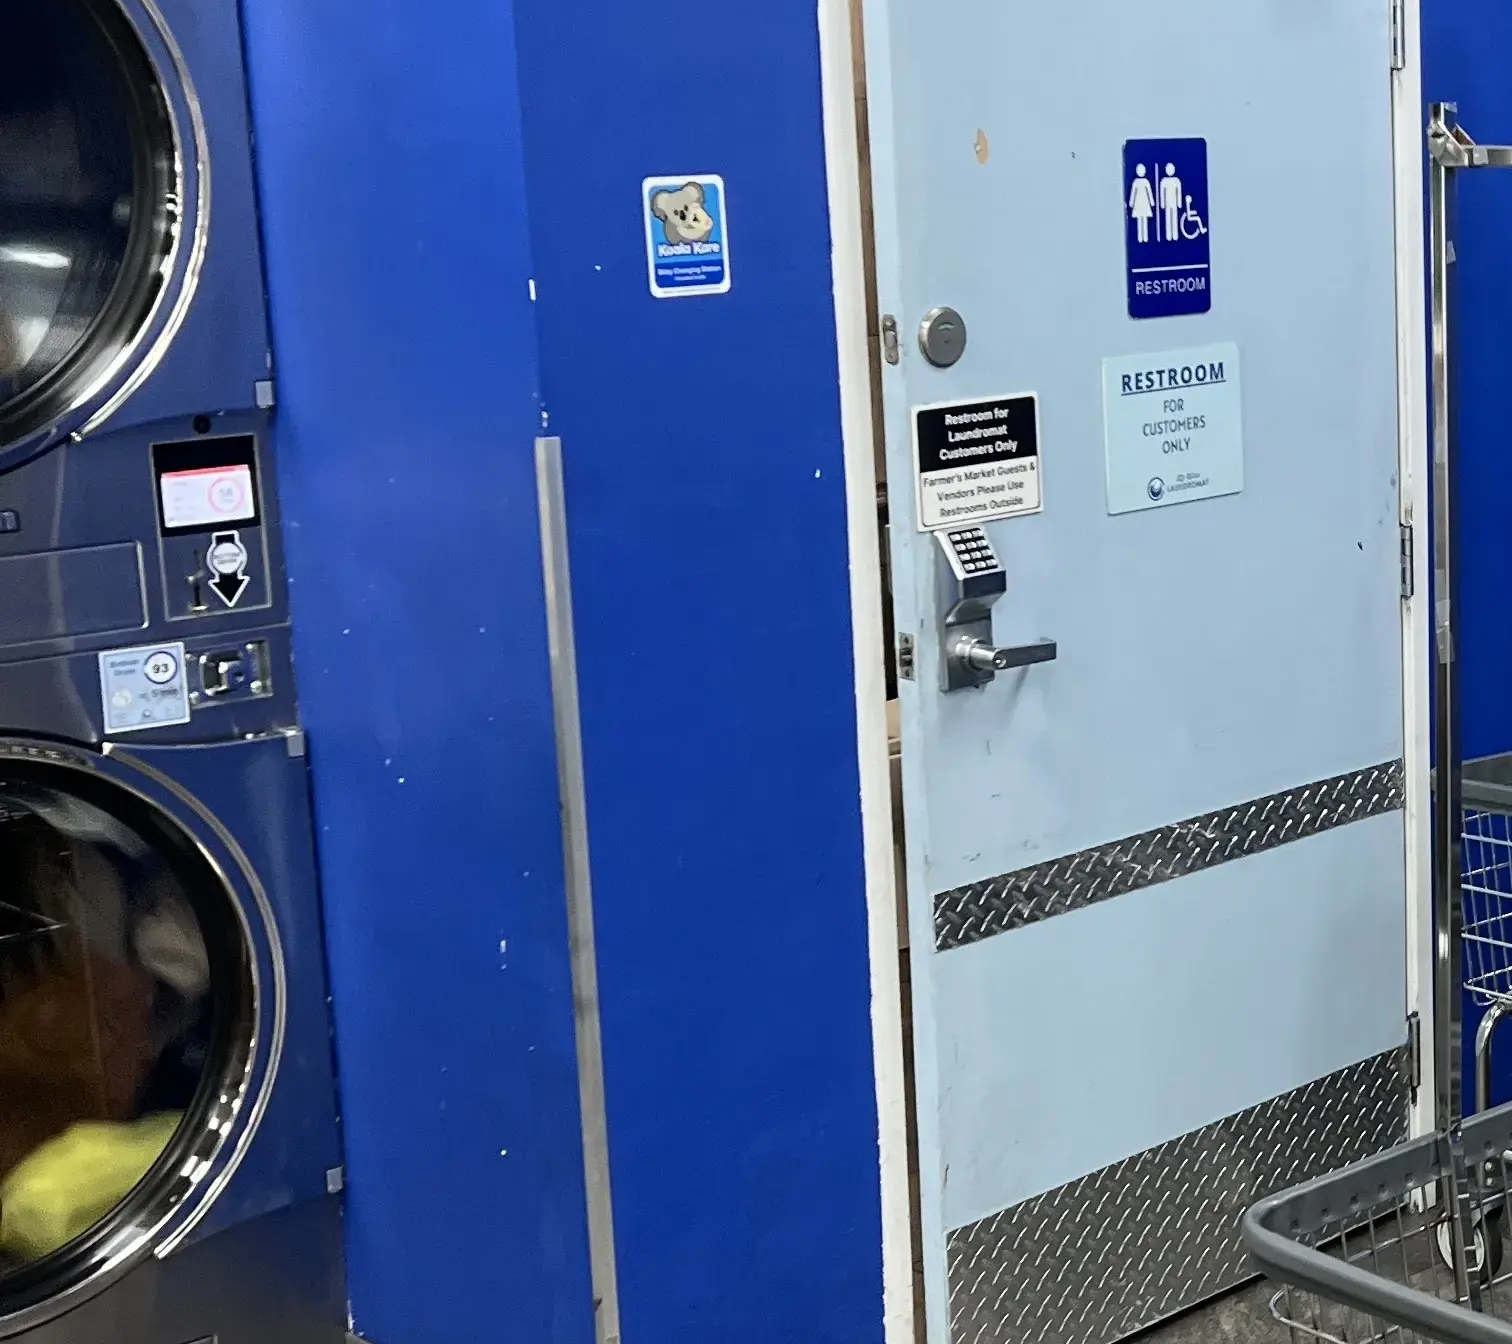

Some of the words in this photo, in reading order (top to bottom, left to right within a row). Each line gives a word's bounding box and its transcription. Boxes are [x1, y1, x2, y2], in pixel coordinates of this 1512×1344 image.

[658, 242, 691, 257] Koala
[693, 242, 720, 254] Kare
[1136, 278, 1205, 295] RESTROOM
[1121, 362, 1225, 393] RESTROOM
[1163, 399, 1184, 414] FOR
[945, 411, 993, 425] Restroom
[994, 407, 1009, 418] for
[948, 425, 1008, 442] Laundromat
[1142, 415, 1206, 437] CUSTOMERS
[939, 445, 993, 460] Customers
[995, 440, 1018, 452] Only
[1162, 437, 1191, 455] ONLY
[923, 474, 962, 487] Farmer's
[964, 468, 995, 480] Market
[997, 464, 1028, 476] Guests
[1029, 461, 1035, 471] &
[937, 489, 975, 501] Vendors
[977, 484, 1005, 495] Please
[1007, 481, 1024, 490] Use
[940, 504, 987, 516] Restrooms
[989, 496, 1024, 509] Outside
[152, 663, 169, 674] 93
